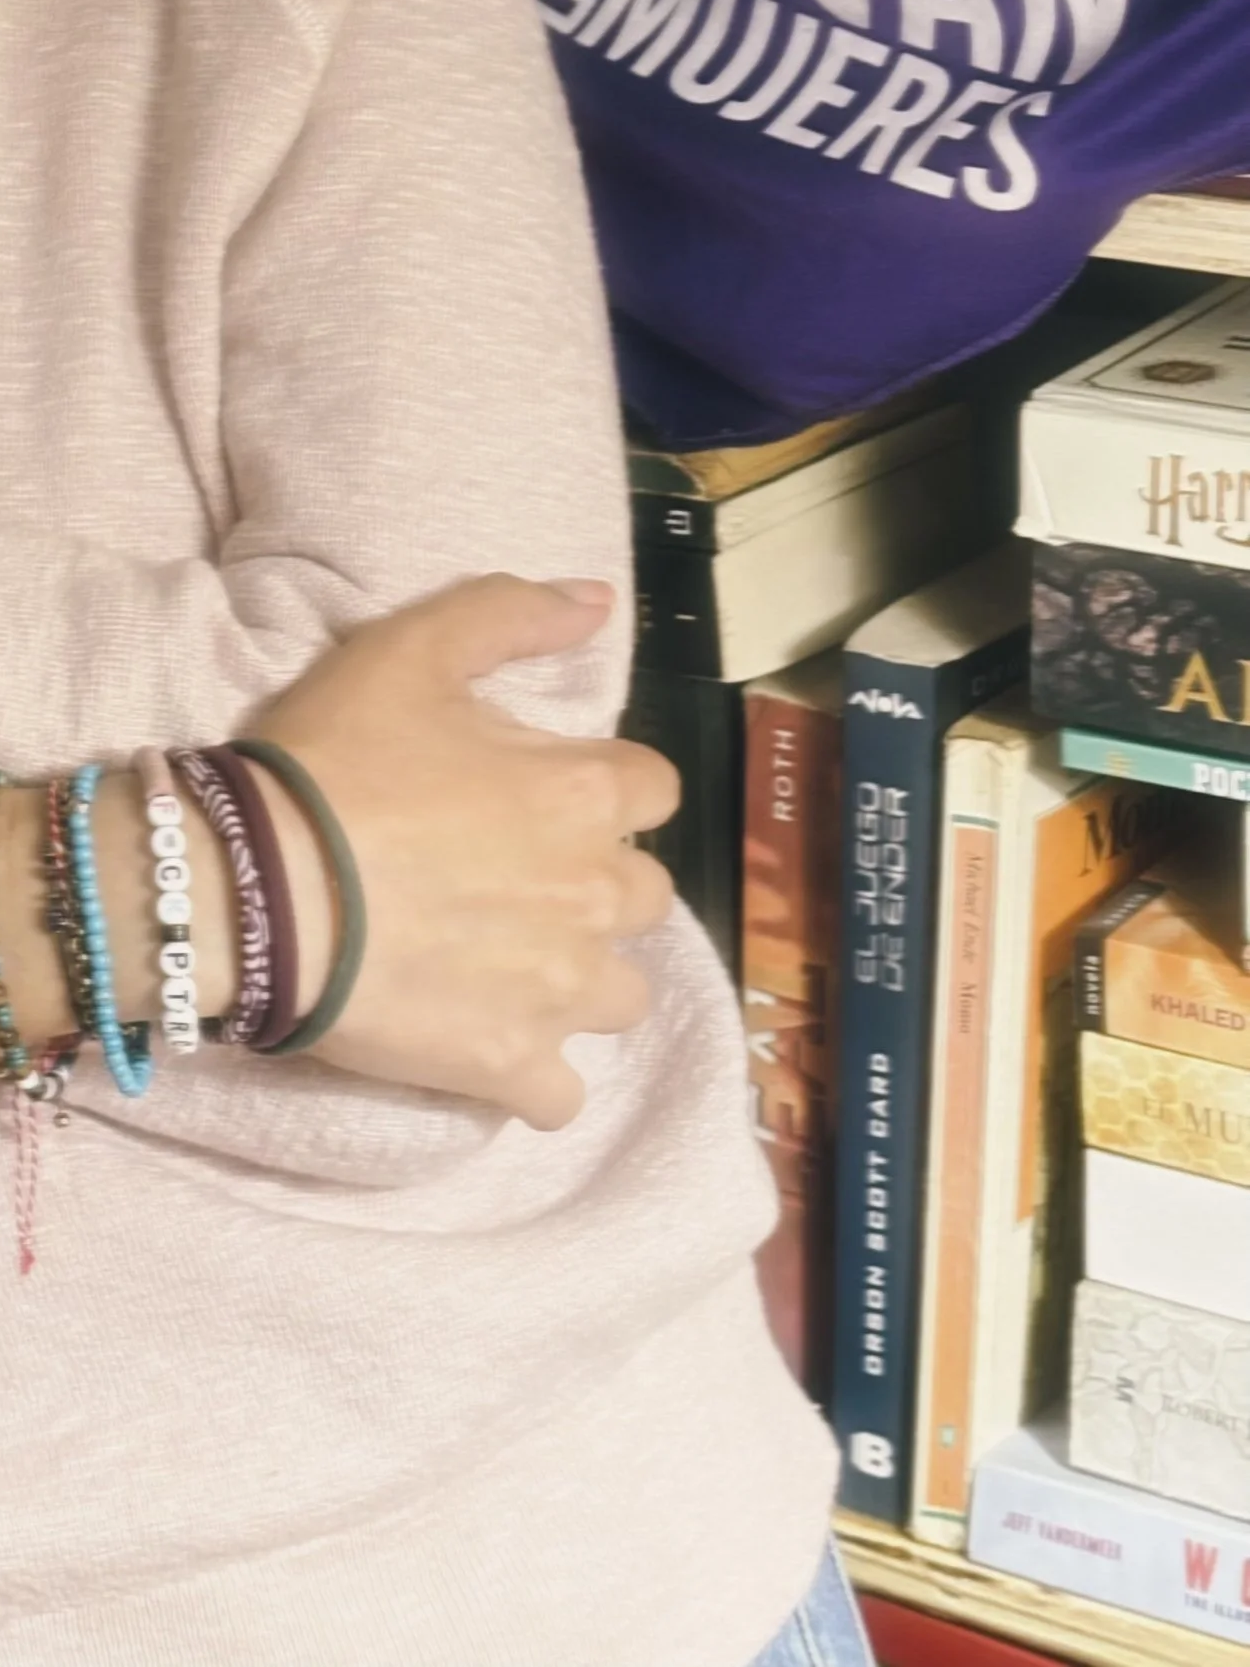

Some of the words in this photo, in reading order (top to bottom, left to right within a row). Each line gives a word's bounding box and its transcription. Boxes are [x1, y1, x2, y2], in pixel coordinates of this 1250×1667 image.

[771, 729, 799, 823] ROTH
[1190, 762, 1250, 802] POC
[855, 781, 881, 925] JUEGO
[880, 787, 910, 925] ENDER
[854, 939, 878, 984] EL
[878, 933, 904, 992] DE
[1150, 991, 1247, 1032] KHALED
[867, 1052, 892, 1138] CARD
[865, 1150, 890, 1252] SCOTT
[862, 1264, 889, 1377] ORSON
[1002, 1511, 1033, 1533] JEFF
